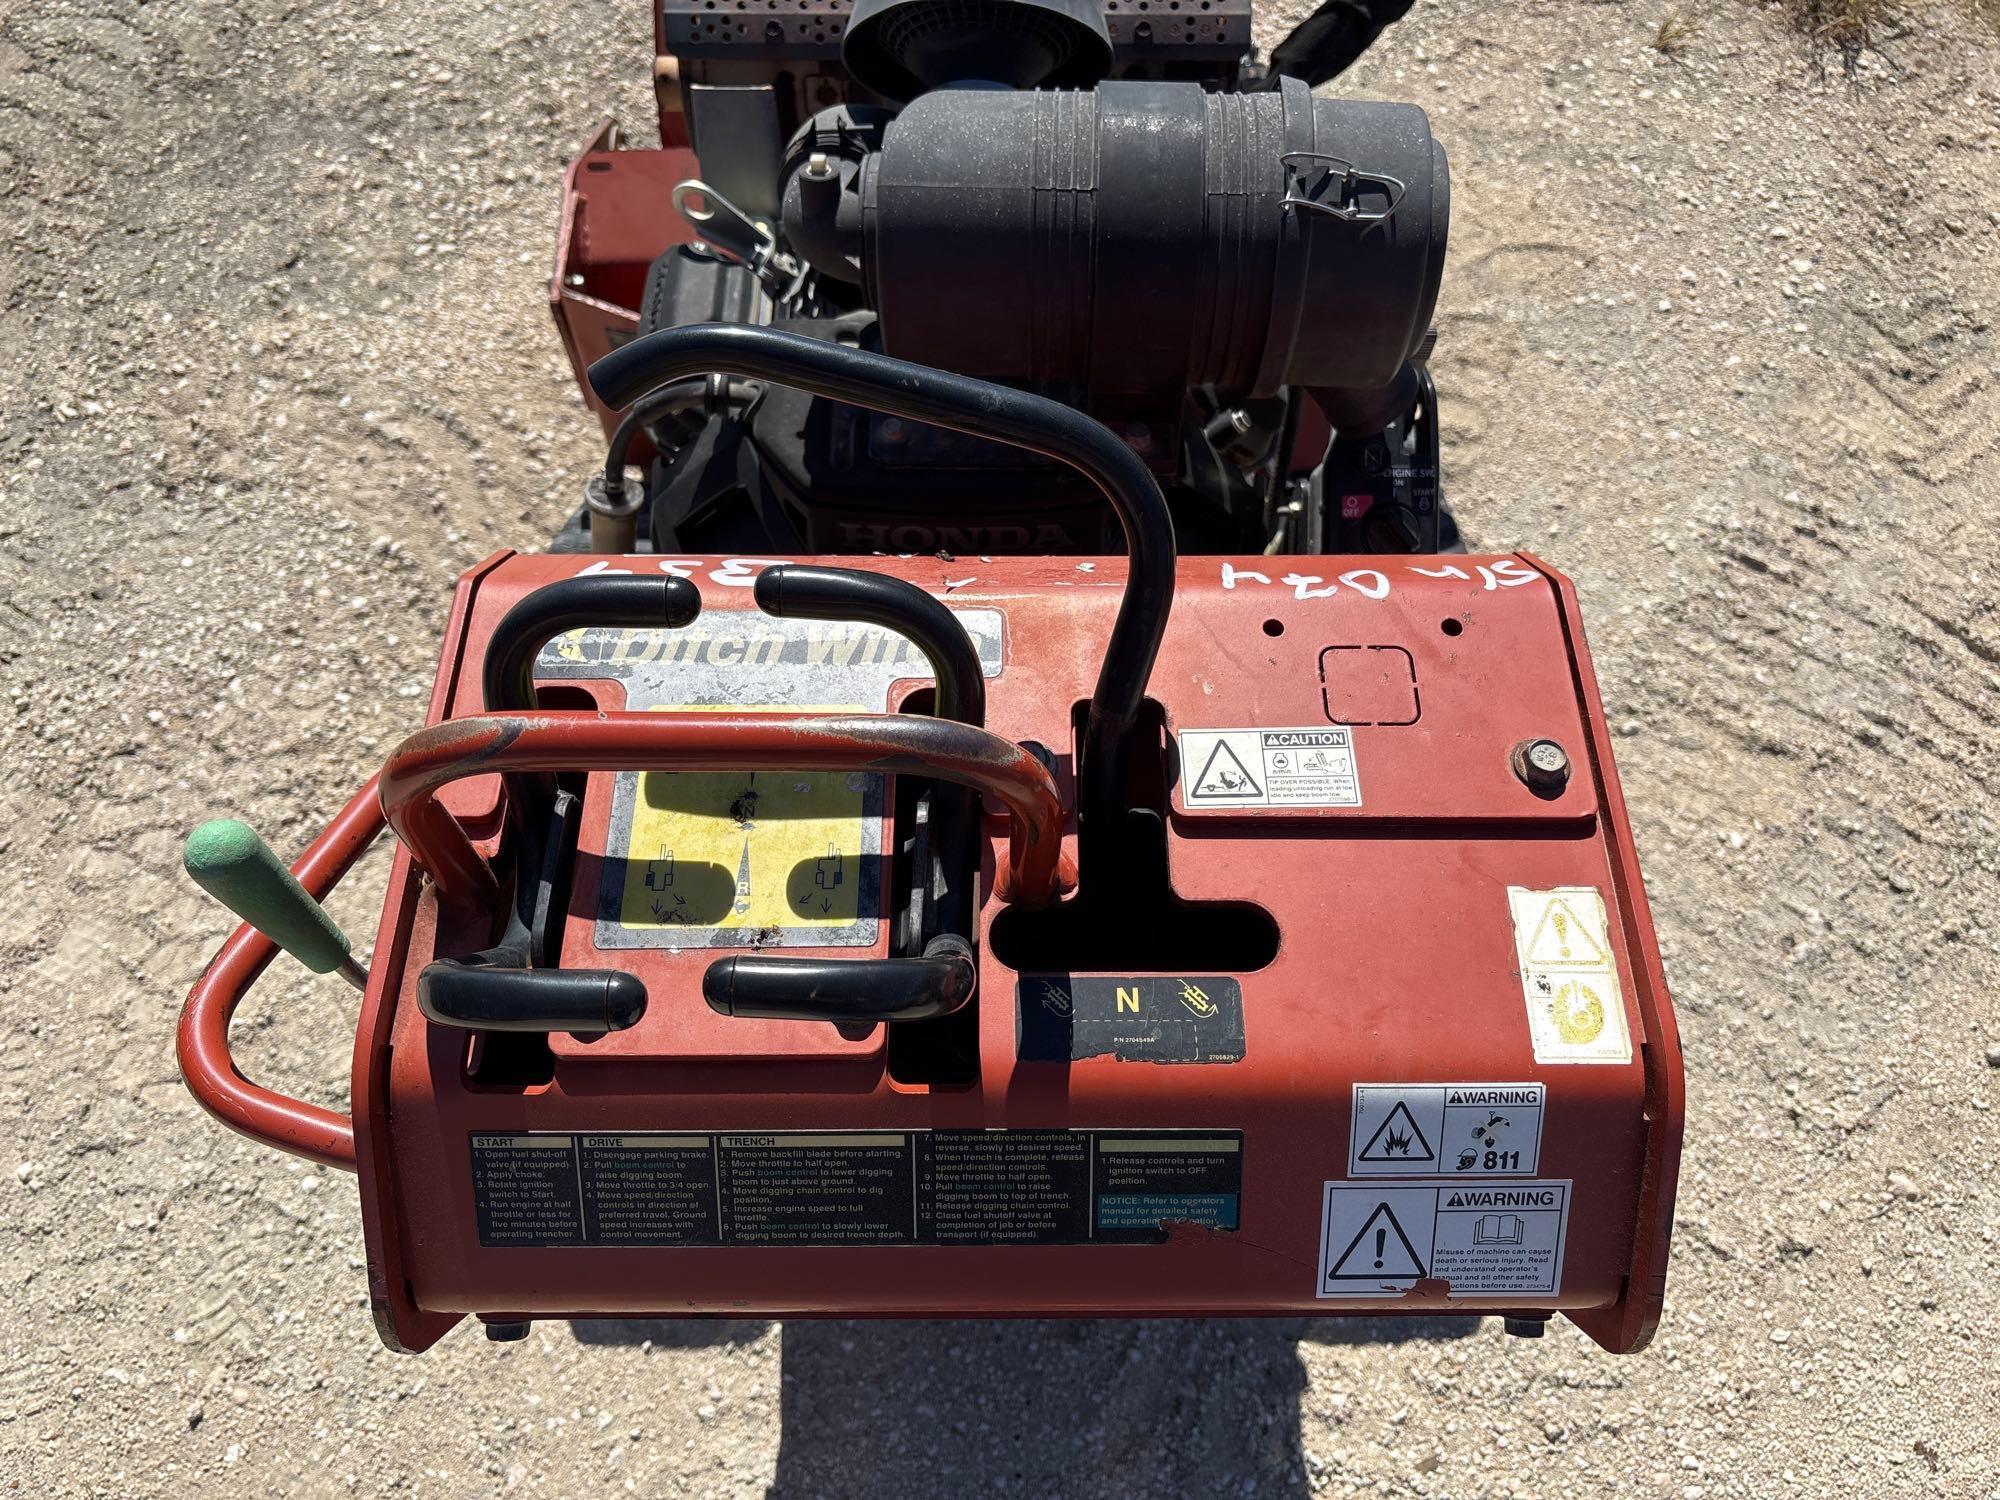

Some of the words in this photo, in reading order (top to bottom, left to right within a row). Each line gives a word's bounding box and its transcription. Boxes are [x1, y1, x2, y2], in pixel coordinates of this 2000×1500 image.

[1343, 508, 1359, 517] OFF
[838, 522, 1076, 549] HONDA
[1279, 733, 1344, 746] CAUTION
[744, 805, 755, 817] N
[737, 881, 749, 893] R
[1116, 987, 1140, 1013] N
[1464, 1091, 1537, 1104] WARNING
[477, 1138, 514, 1146] START
[727, 1138, 774, 1146] TRENCH
[962, 1134, 1032, 1142] speed/direction
[589, 1138, 623, 1148] DRIVE
[975, 1144, 1003, 1152] slowly
[1054, 1144, 1083, 1152] speed.
[532, 1150, 566, 1158] shut-off
[594, 1151, 641, 1160] Disengage
[645, 1151, 678, 1160] parking
[681, 1151, 709, 1159] brake.
[866, 1150, 902, 1159] starting.
[1005, 1153, 1048, 1162] complete,
[486, 1160, 509, 1168] valve
[524, 1160, 572, 1170] equipped).
[643, 1160, 674, 1169] control
[759, 1159, 791, 1167] throttle
[1483, 1151, 1519, 1170] 811
[936, 1163, 1006, 1172] speed/direction
[1110, 1166, 1142, 1176] ignition
[1146, 1166, 1174, 1174] switch
[487, 1170, 513, 1180] Apply
[514, 1170, 545, 1178] choke.
[596, 1171, 617, 1179] raise
[620, 1171, 654, 1180] digging
[657, 1171, 684, 1179] boom.
[786, 1168, 817, 1176] control
[859, 1168, 892, 1178] digging
[963, 1172, 996, 1180] throttle
[488, 1180, 517, 1188] Rotate
[520, 1180, 553, 1190] ignition
[623, 1180, 655, 1188] throttle
[686, 1182, 711, 1190] open.
[821, 1178, 855, 1186] ground.
[984, 1182, 1014, 1190] control
[1109, 1177, 1147, 1186] position.
[489, 1190, 518, 1198] switch
[532, 1190, 556, 1198] Start.
[624, 1191, 694, 1200] speed/direction
[760, 1186, 793, 1196] digging
[823, 1186, 854, 1194] control
[734, 1196, 772, 1205] position.
[936, 1192, 969, 1201] digging
[1463, 1192, 1554, 1206] WARNING
[511, 1200, 542, 1209] engine
[974, 1202, 1007, 1211] digging
[1102, 1198, 1140, 1206] NOTICE:
[1182, 1198, 1224, 1208] operators
[734, 1204, 772, 1212] Increase
[775, 1204, 805, 1214] engine
[1190, 1207, 1218, 1216] safety
[491, 1210, 523, 1218] throttle
[599, 1211, 640, 1220] preferred
[984, 1211, 1015, 1219] shutoff
[600, 1221, 626, 1230] speed
[834, 1222, 861, 1231] slowly
[936, 1221, 985, 1230] completion
[491, 1230, 533, 1239] operating
[736, 1231, 769, 1240] digging
[878, 1231, 905, 1240] depth.
[936, 1230, 976, 1239] transport
[992, 1230, 1038, 1239] equipped).
